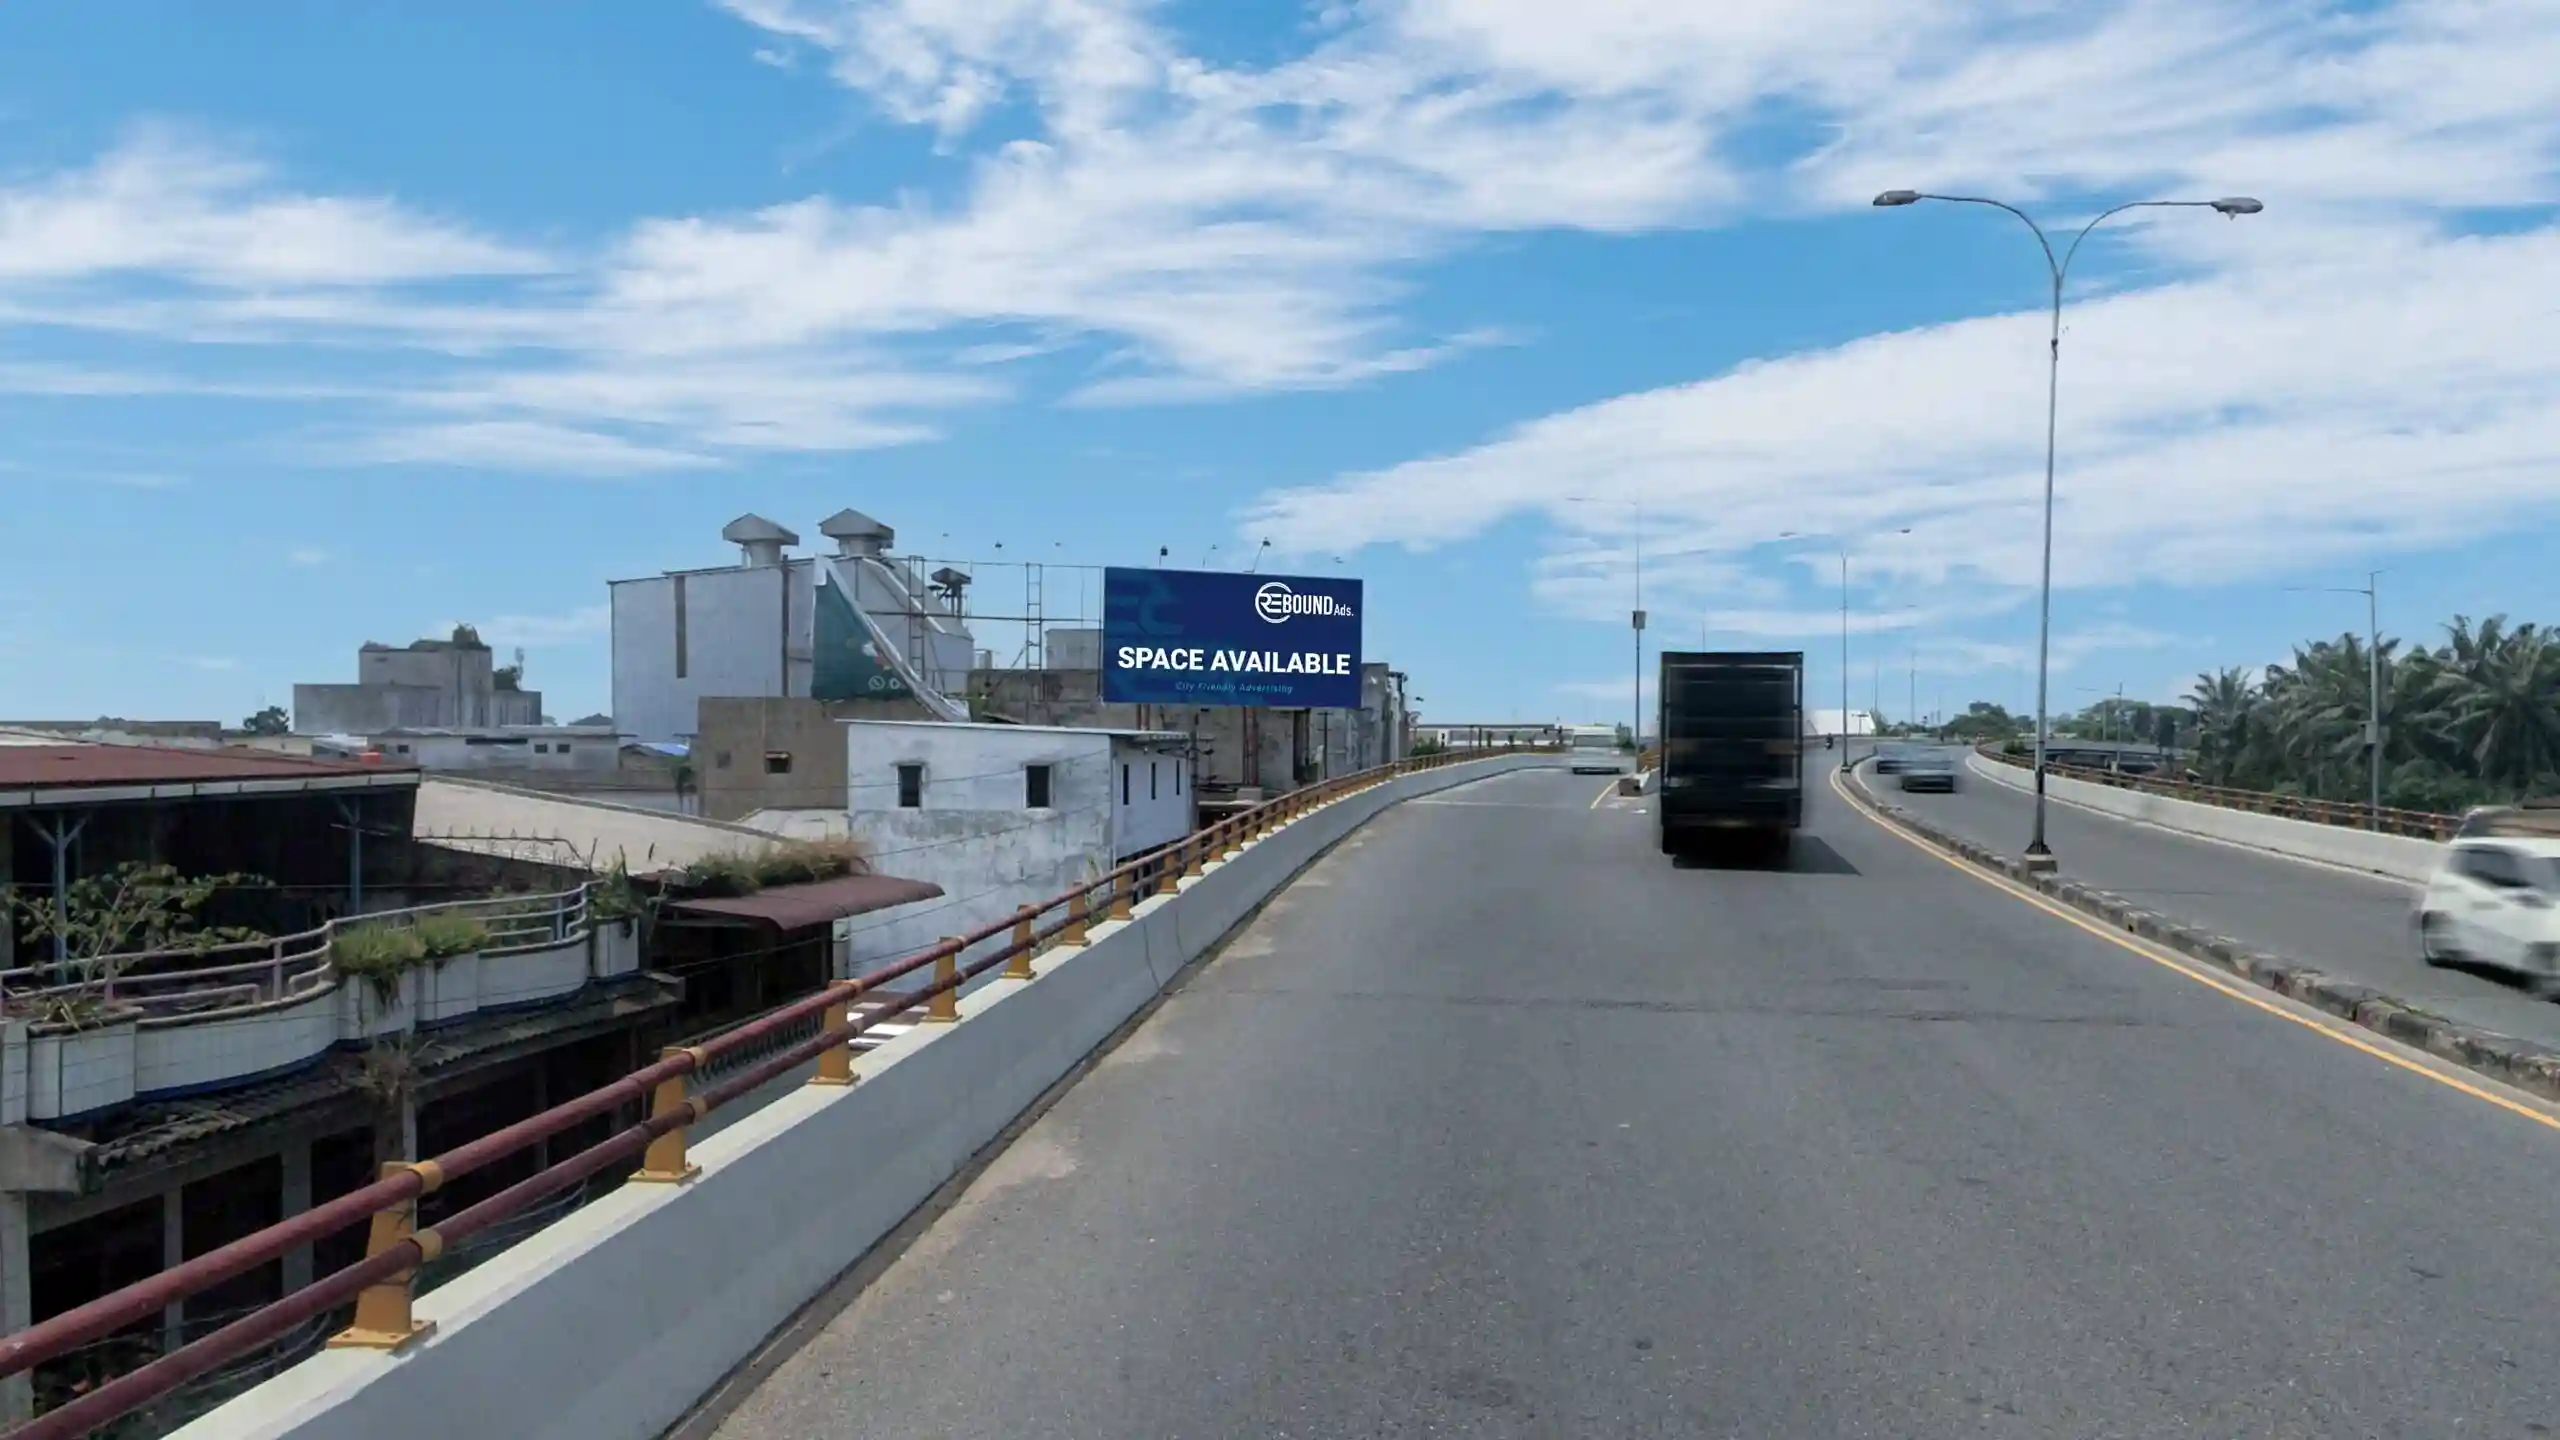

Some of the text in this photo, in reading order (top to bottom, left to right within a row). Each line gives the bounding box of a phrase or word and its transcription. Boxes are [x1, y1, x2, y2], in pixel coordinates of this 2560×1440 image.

[1334, 604, 1354, 616] Ads.
[1118, 647, 1351, 675] SPACE AVAILABLE
[1175, 681, 1293, 695] City Friendly Advertising
